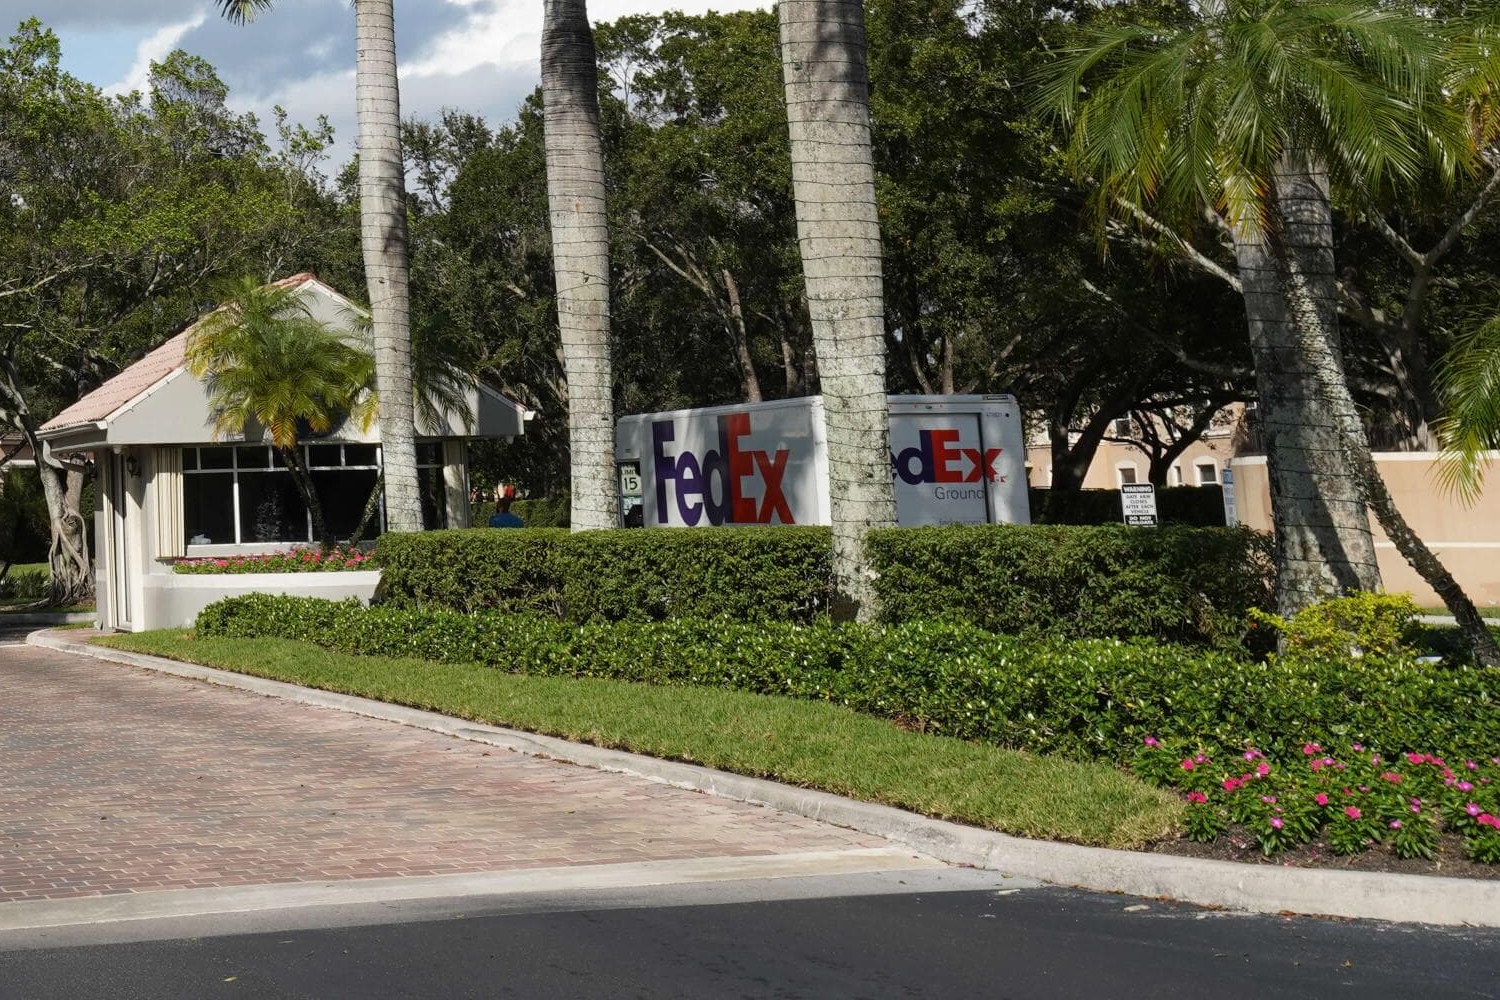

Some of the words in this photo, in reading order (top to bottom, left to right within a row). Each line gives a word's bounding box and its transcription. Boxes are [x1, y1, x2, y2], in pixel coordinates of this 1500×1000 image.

[652, 412, 796, 527] FedEx
[890, 429, 1003, 486] dEx
[624, 477, 638, 490] 15
[934, 486, 986, 500] Ground
